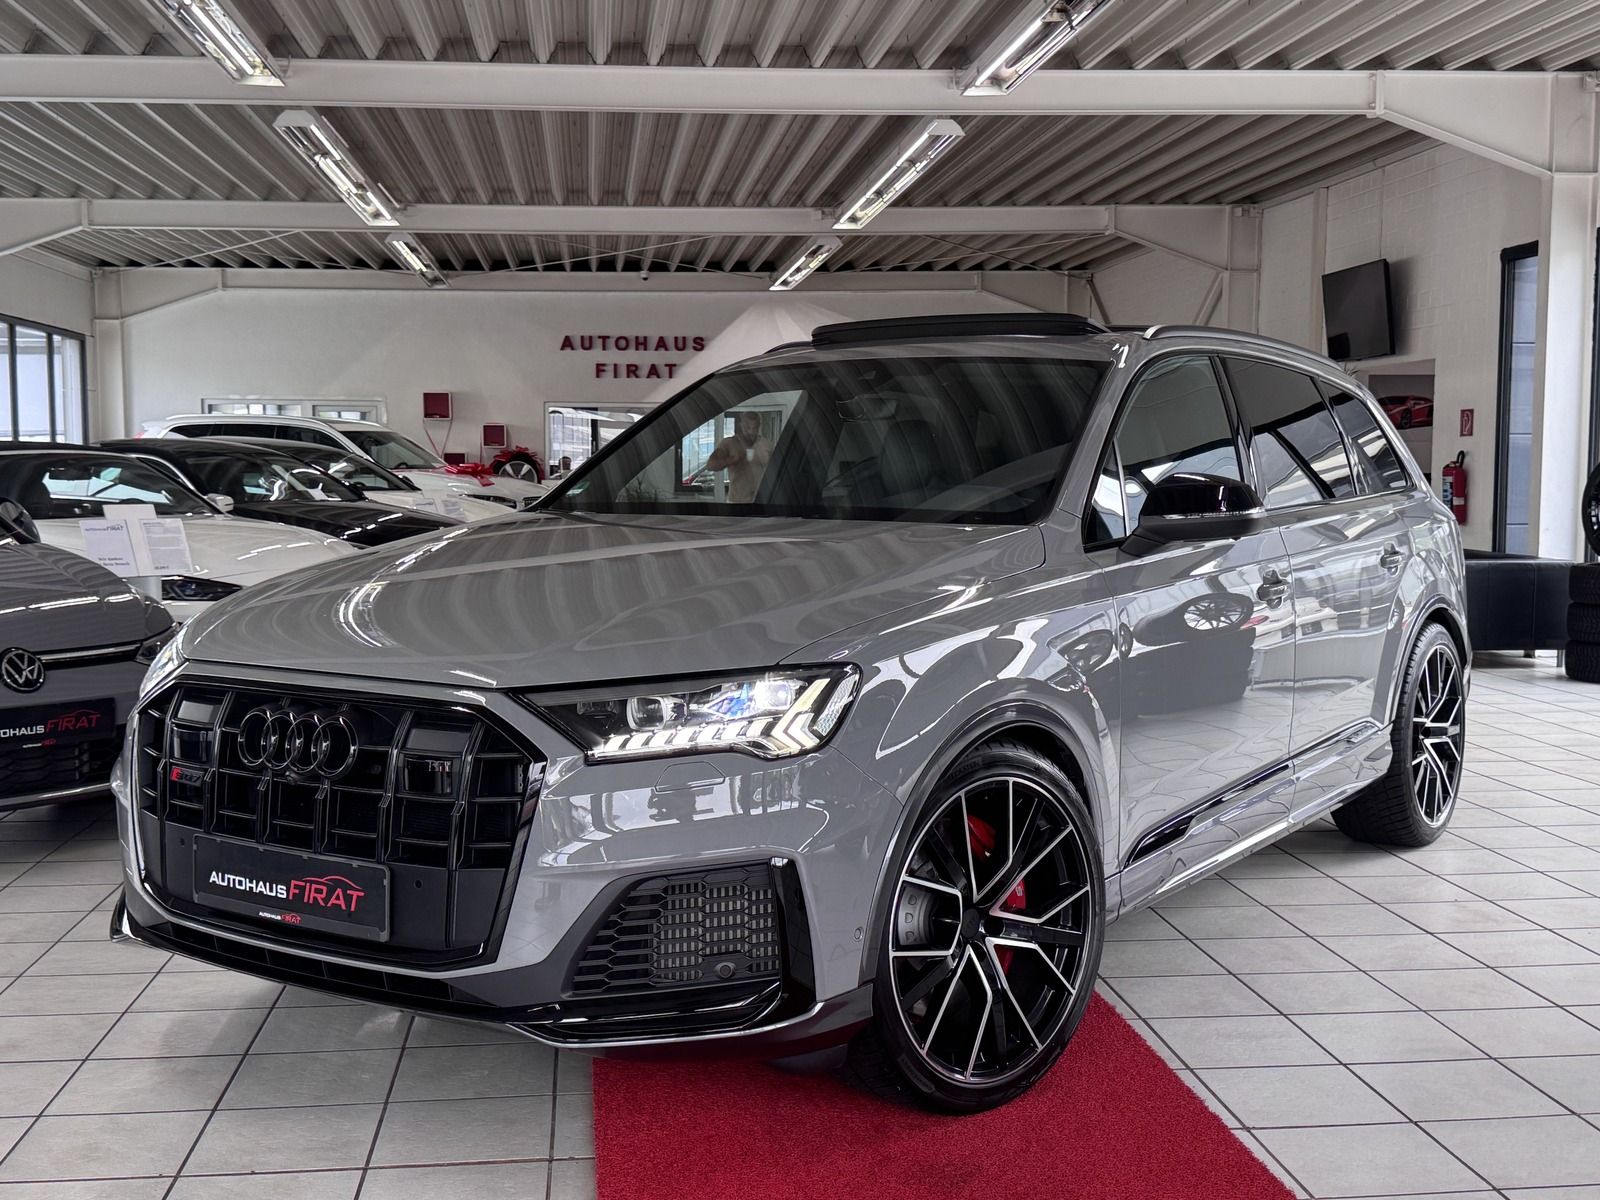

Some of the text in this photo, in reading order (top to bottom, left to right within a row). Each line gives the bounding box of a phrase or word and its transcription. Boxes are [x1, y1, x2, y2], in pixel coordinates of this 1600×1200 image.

[559, 335, 705, 351] AUTOHAUS
[595, 363, 677, 379] FIRAT
[0, 713, 101, 738] OHAUS FIRAT
[209, 871, 365, 912] AUTOHAUS FIRAT
[281, 914, 301, 924] FIRAT
